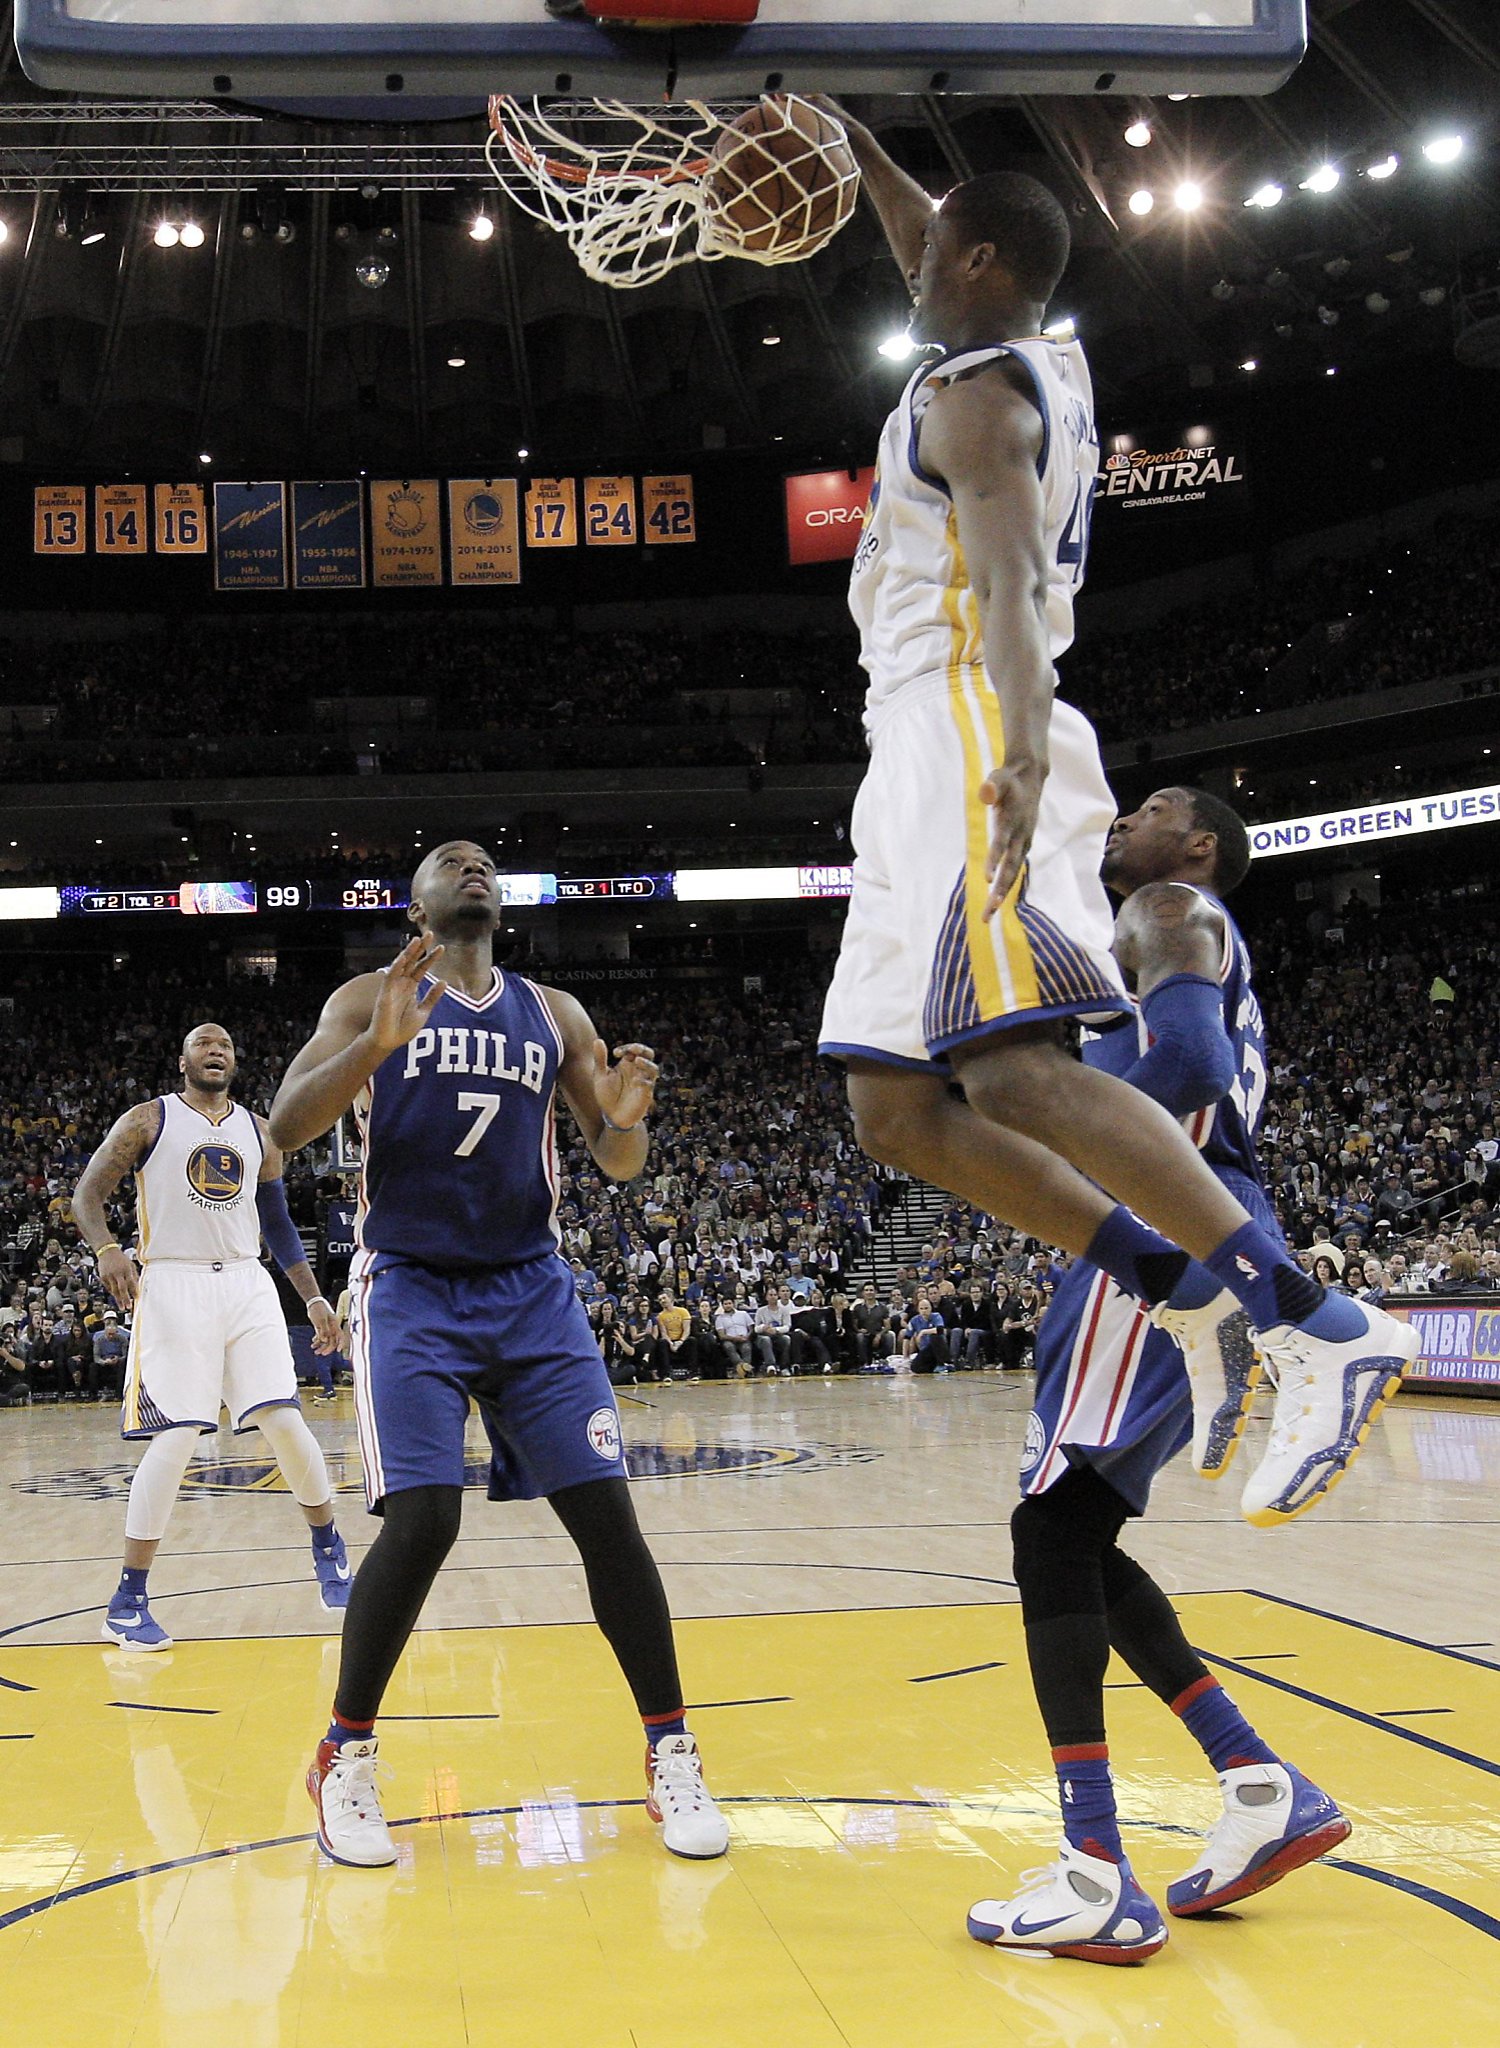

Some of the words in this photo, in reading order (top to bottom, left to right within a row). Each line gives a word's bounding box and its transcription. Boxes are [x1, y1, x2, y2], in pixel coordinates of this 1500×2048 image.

[1093, 456, 1244, 498] CENTRAL
[1122, 492, 1206, 508] CSNBAYAREA.COM
[534, 504, 566, 538] 17
[589, 502, 631, 537] 24
[649, 501, 691, 535] 42
[43, 510, 78, 545] 13
[104, 510, 138, 545] 14
[164, 509, 198, 545] 16
[224, 549, 278, 559] 1946-1947
[301, 548, 356, 558] 1955-1956
[380, 546, 434, 556] 1974-1975
[457, 545, 513, 555] 2014-2015
[240, 566, 260, 575] NBA
[319, 565, 338, 574] NBA
[397, 563, 417, 571] NBA
[475, 562, 495, 570] NBA
[223, 576, 279, 584] CHAMPIONS
[301, 574, 357, 583] CHAMPIONS
[380, 572, 435, 581] CHAMPIONS
[458, 571, 514, 579] CHAMPIONS
[1248, 825, 1311, 851] OND
[1320, 808, 1412, 840] GREEN
[1421, 791, 1500, 823] TUES
[800, 867, 853, 886] KNBR
[353, 879, 380, 890] 4TH
[560, 885, 582, 896] TOL
[583, 883, 595, 895] 2
[598, 882, 608, 894] 1
[617, 883, 633, 894] TF
[632, 881, 644, 894] 0
[91, 897, 107, 908] TF
[107, 896, 119, 908] 2
[129, 897, 151, 907] TOL
[153, 895, 164, 907] 2
[167, 895, 177, 906] 1
[266, 886, 301, 907] 99
[342, 889, 391, 908] 9:51
[554, 969, 605, 981] CASINO
[607, 968, 656, 979] RESORT
[403, 1027, 547, 1094] PHILA
[453, 1091, 501, 1157] 7
[219, 1155, 232, 1171] 5
[186, 1188, 245, 1212] WARRIORS
[1430, 1361, 1468, 1378] SPORTS
